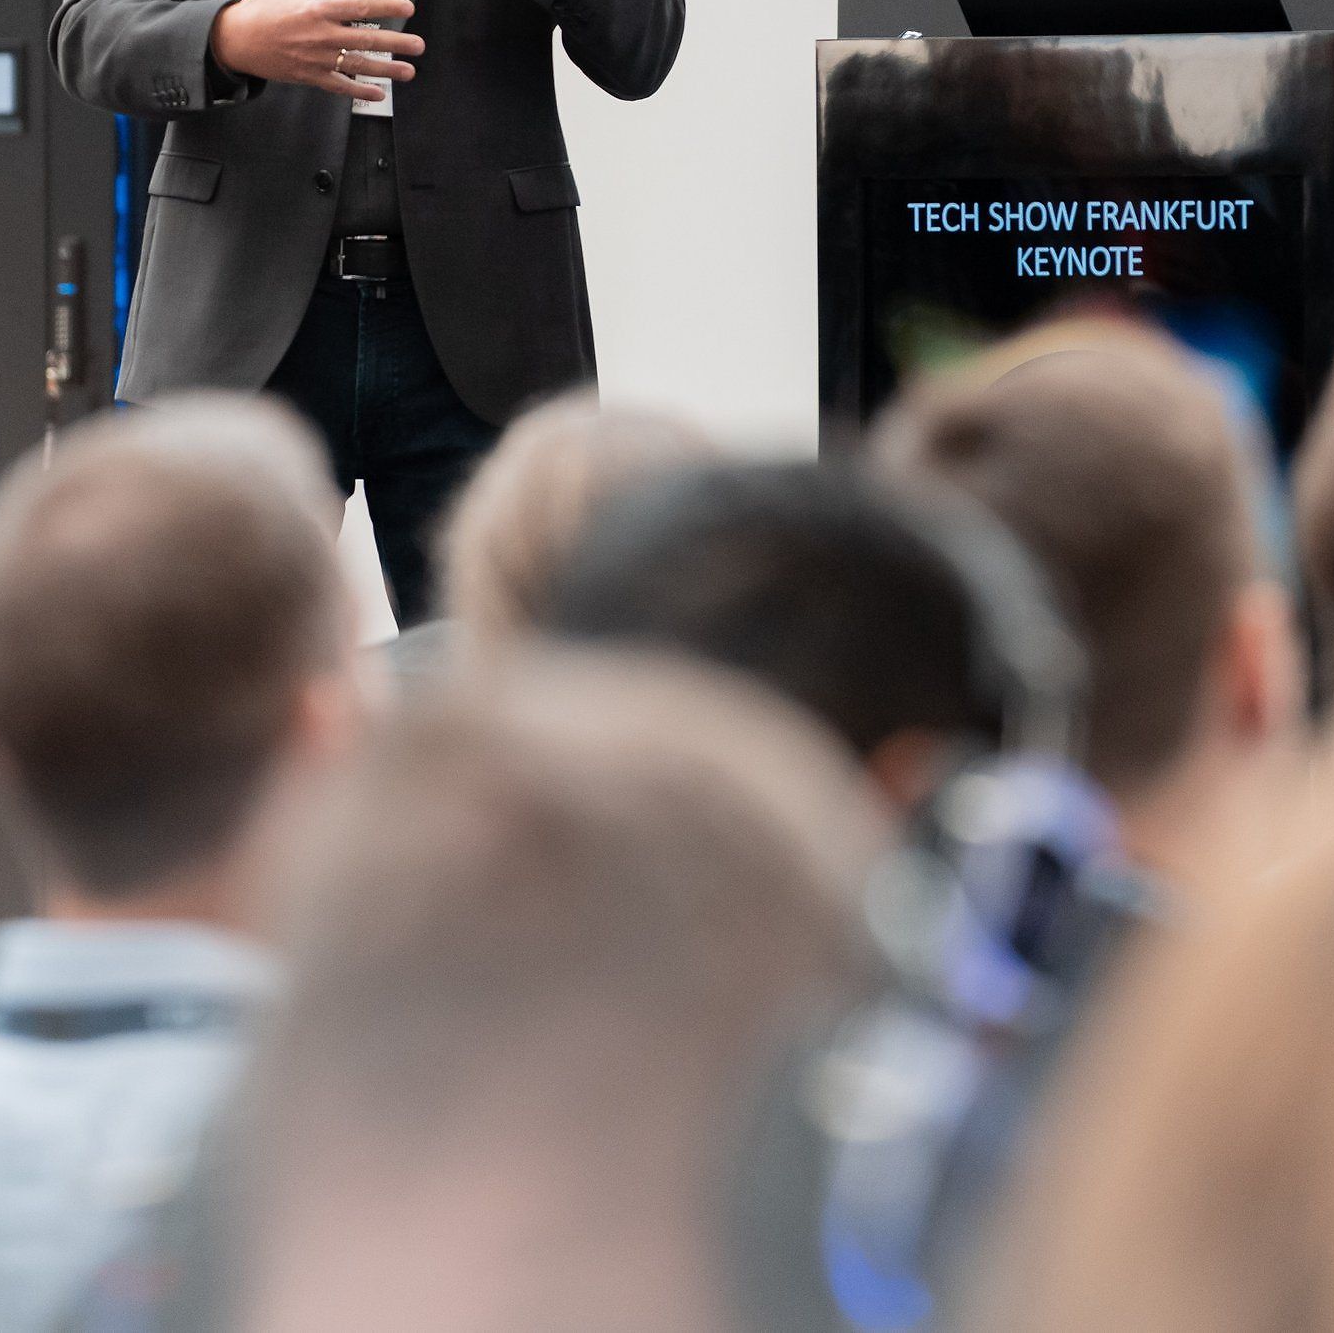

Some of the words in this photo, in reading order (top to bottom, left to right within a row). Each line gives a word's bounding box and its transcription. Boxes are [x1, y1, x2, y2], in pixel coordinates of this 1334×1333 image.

[907, 202, 979, 232] TECH
[988, 201, 1078, 232] SHOW
[1087, 199, 1254, 231] FRANKFURT
[1017, 246, 1144, 277] KEYNOTE
